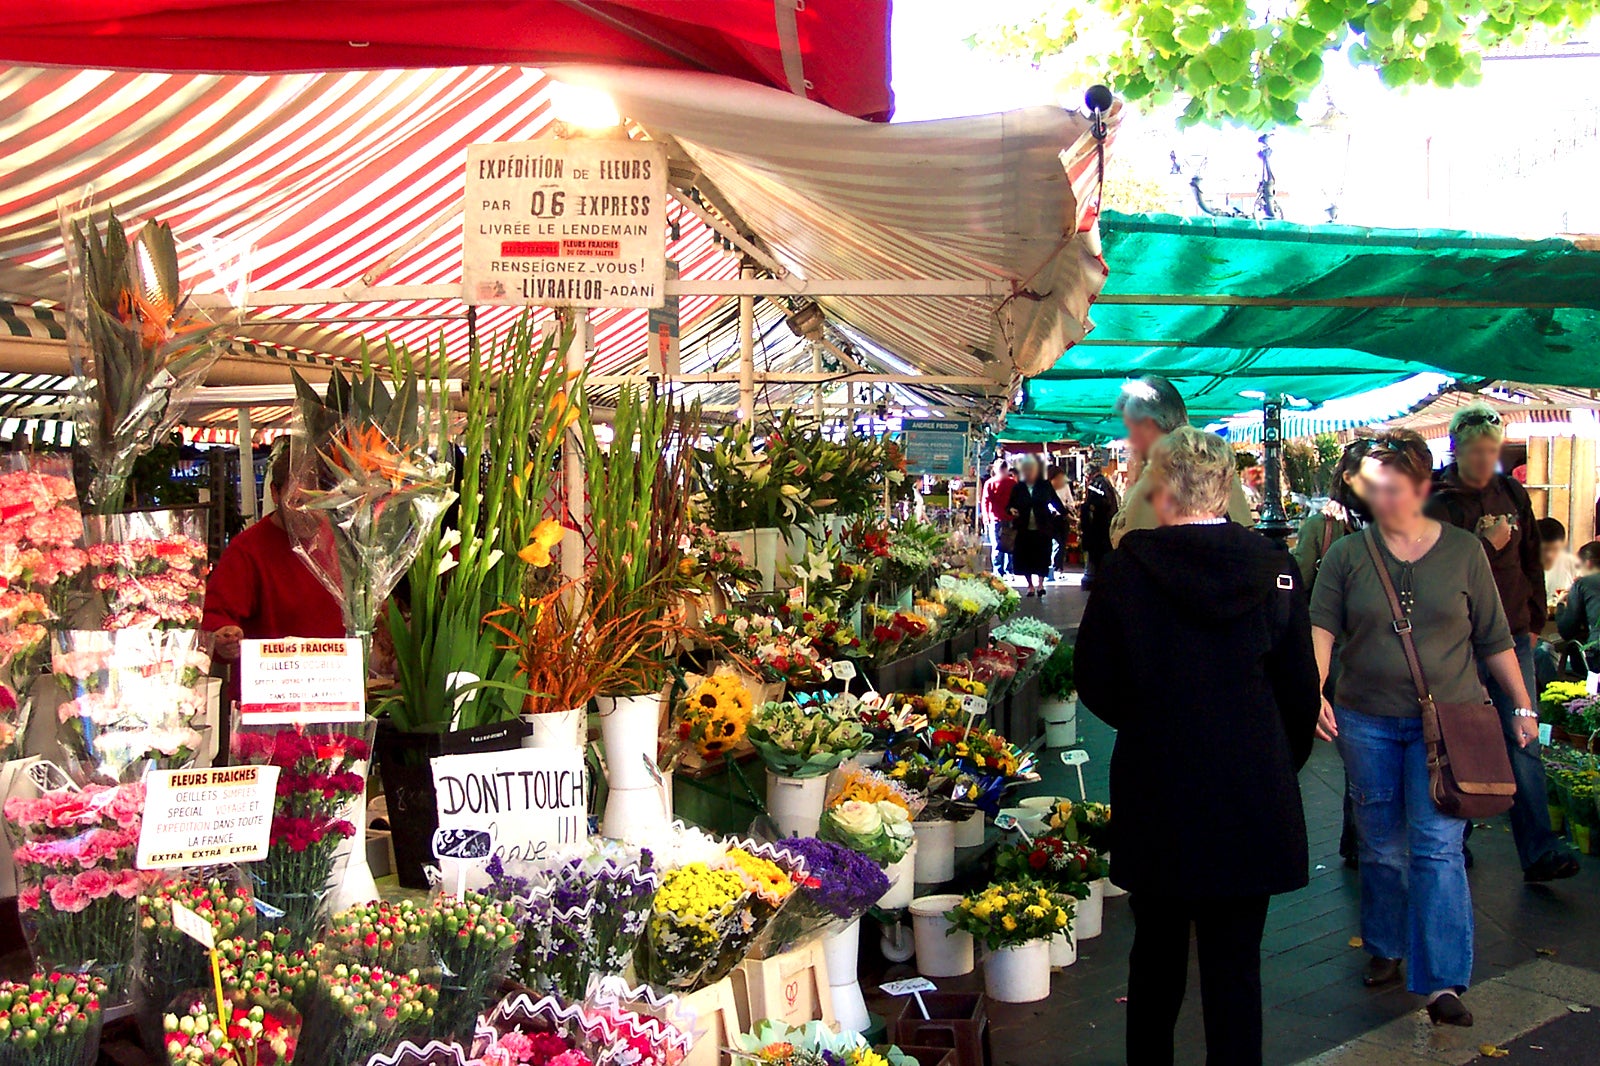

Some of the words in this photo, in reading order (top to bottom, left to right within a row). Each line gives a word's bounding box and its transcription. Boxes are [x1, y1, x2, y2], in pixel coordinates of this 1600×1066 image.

[479, 155, 564, 180] EXPÉDITION
[573, 168, 589, 180] DE
[600, 159, 651, 180] FLEURS
[482, 200, 511, 211] PAR
[531, 190, 565, 217] 06
[576, 195, 650, 217] EXPRESS
[480, 221, 530, 235] LIVRÉE
[538, 224, 555, 235] LE
[562, 225, 648, 236] LENDEMAIN
[563, 240, 586, 248] FLEURS
[588, 241, 619, 249] FRAICHES
[263, 643, 297, 654] FLEURS
[301, 643, 345, 653] FRAICHES
[171, 773, 208, 787] FLEURS
[212, 769, 257, 784] FRAICHES
[176, 790, 218, 802] OEILLETS
[518, 770, 583, 810] TOUCH
[167, 807, 203, 819] SPECIAL
[249, 800, 259, 811] ET
[156, 821, 211, 834] EXPEDITION
[213, 818, 235, 830] DANS
[238, 815, 264, 827] TOUTE
[188, 837, 199, 847] LA
[201, 833, 234, 847] FRANCE
[151, 853, 183, 862] EXTRA
[191, 849, 222, 859] EXTRA
[230, 845, 258, 854] EXTRA
